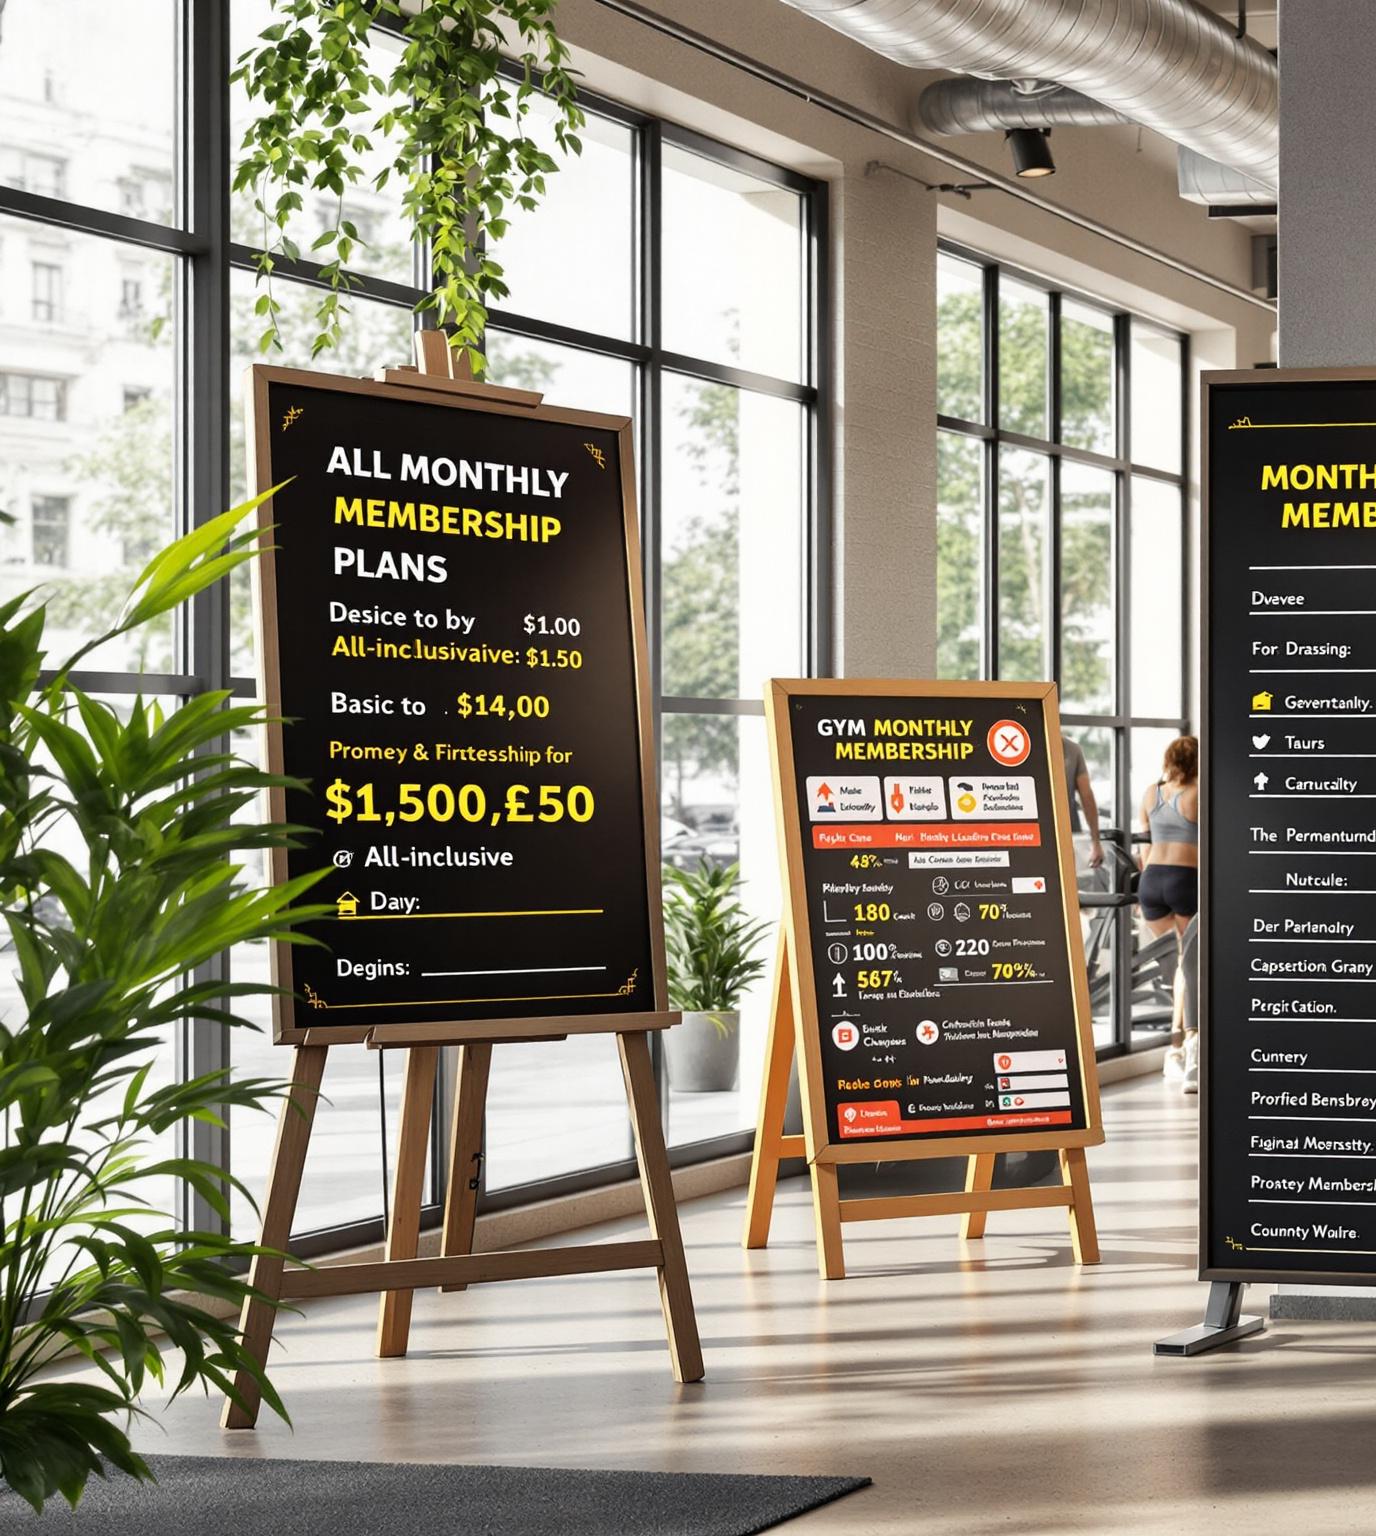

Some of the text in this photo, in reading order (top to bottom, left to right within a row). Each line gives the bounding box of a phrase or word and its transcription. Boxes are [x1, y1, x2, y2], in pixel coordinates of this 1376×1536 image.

[326, 446, 570, 499] ALL MONTHLY
[334, 496, 562, 543] MEMBERSHIP
[334, 546, 448, 584] PLANS
[329, 601, 581, 637] Desice to by $1.00
[526, 647, 583, 669] $1.50
[1252, 641, 1279, 656] For
[1286, 641, 1351, 659] Drassing:
[331, 691, 550, 721] Basic to $14,00
[817, 718, 973, 737] GYM MONTHLY
[412, 743, 430, 761] &
[545, 745, 573, 764] for
[835, 742, 974, 760] MEMBERSHIP
[325, 778, 595, 827] $1,500,£50
[1249, 827, 1278, 842] The
[364, 845, 514, 868] All-inclusive
[854, 903, 891, 922] 180
[1253, 918, 1280, 933] Der
[955, 938, 990, 956] 220
[336, 958, 410, 981] Degins:
